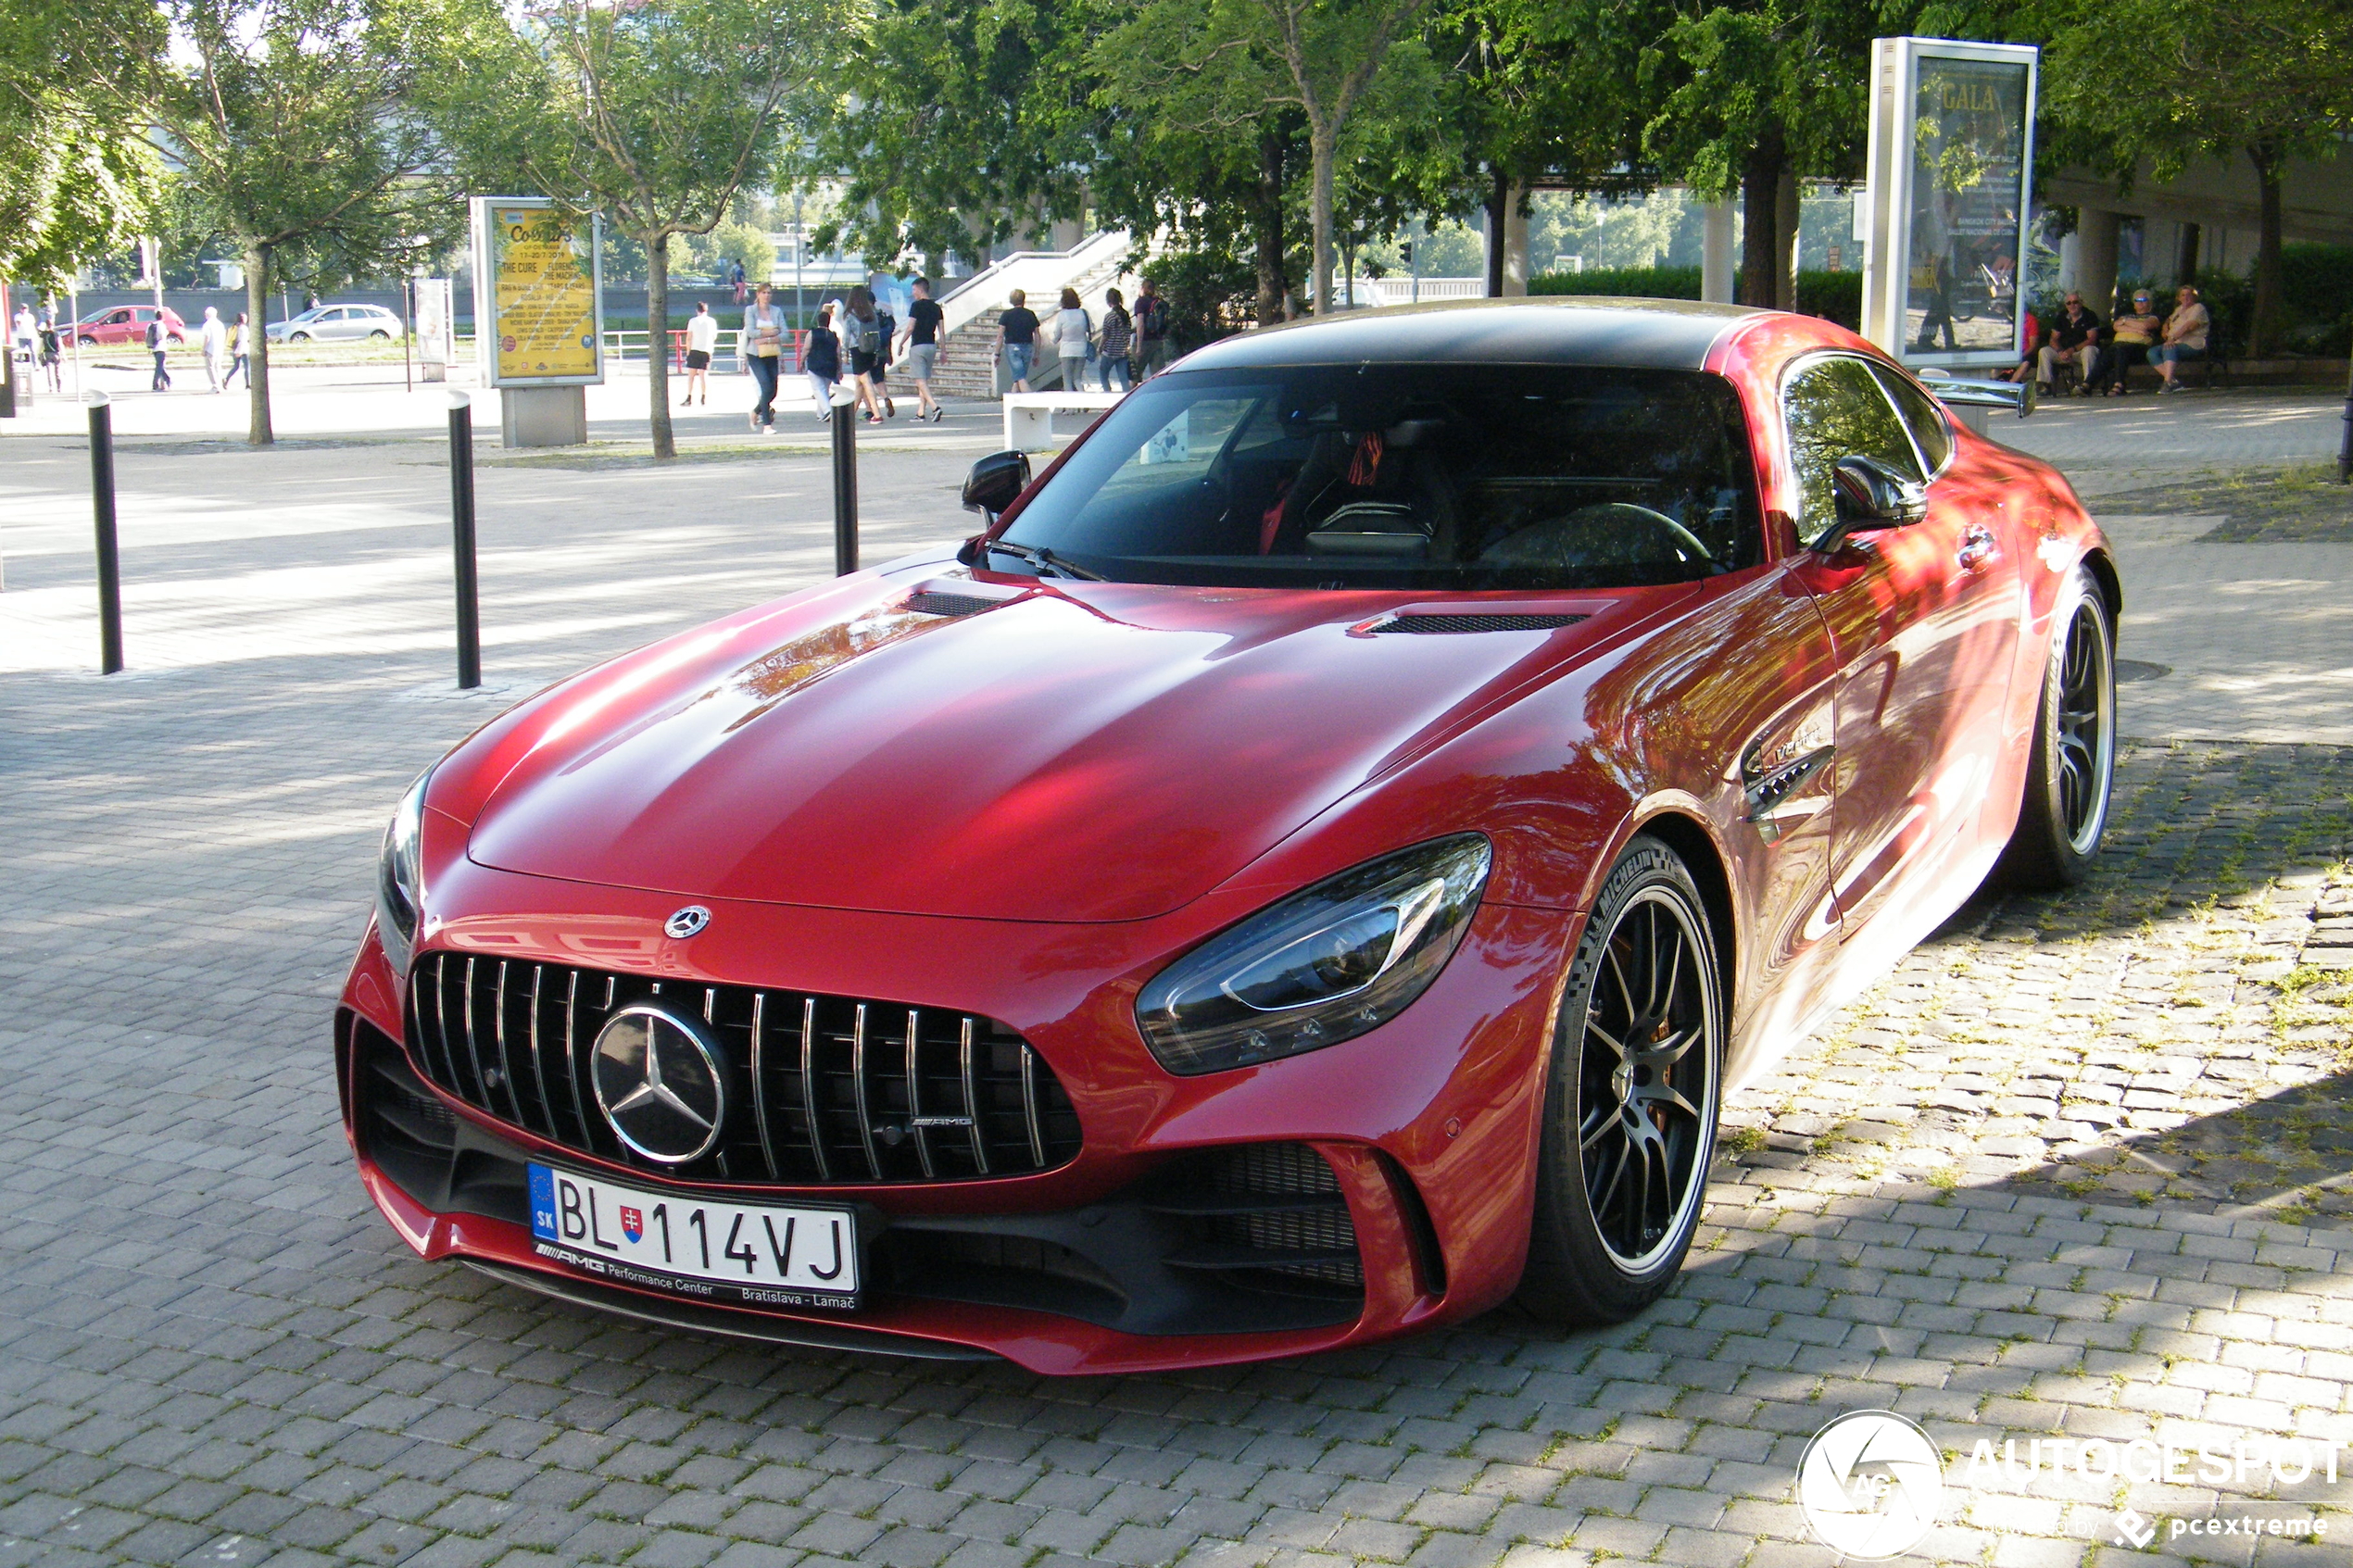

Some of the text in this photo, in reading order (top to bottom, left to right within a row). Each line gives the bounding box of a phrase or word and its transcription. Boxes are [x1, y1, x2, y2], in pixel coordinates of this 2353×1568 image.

[1943, 82, 1994, 111] GALA
[1985, 218, 1996, 226] CITY
[503, 262, 537, 273] THE CURE
[1598, 849, 1652, 917] MICHELIN
[536, 1210, 554, 1229] SK
[559, 1178, 842, 1281] BL 114VJ
[556, 1248, 606, 1273] AMG
[608, 1264, 673, 1288] Performance
[674, 1279, 713, 1295] Center
[742, 1288, 802, 1305] Bratislava
[812, 1295, 855, 1310] Lamač
